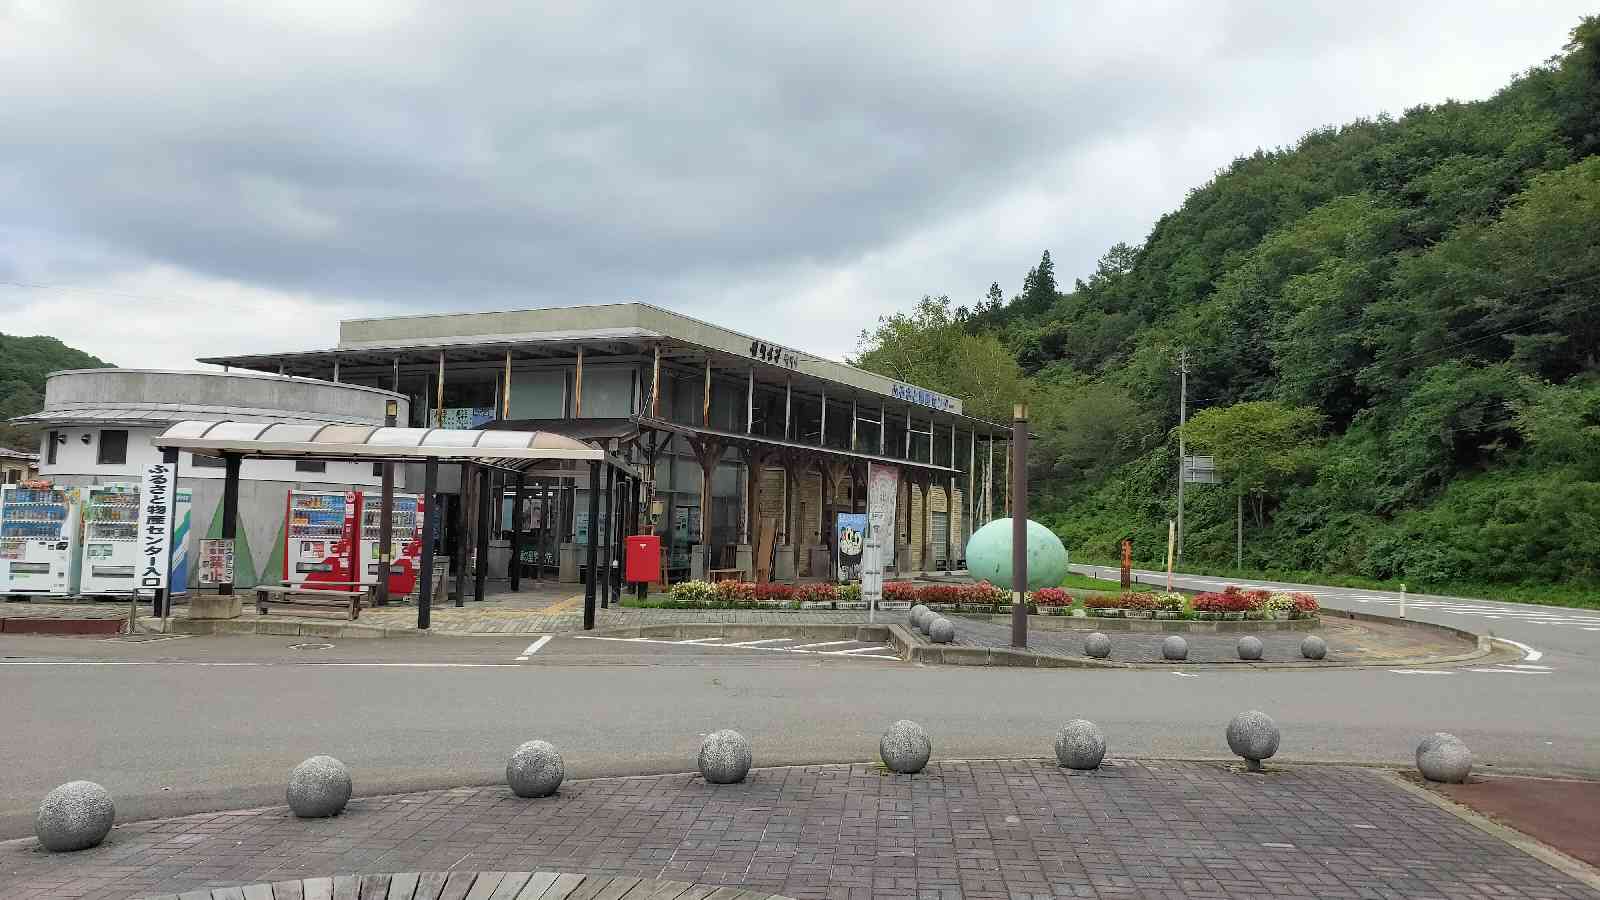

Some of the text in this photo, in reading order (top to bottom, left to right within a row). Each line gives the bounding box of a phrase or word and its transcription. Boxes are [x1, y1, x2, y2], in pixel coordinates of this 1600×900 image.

[142, 464, 169, 587] ふるさと物産センター入口
